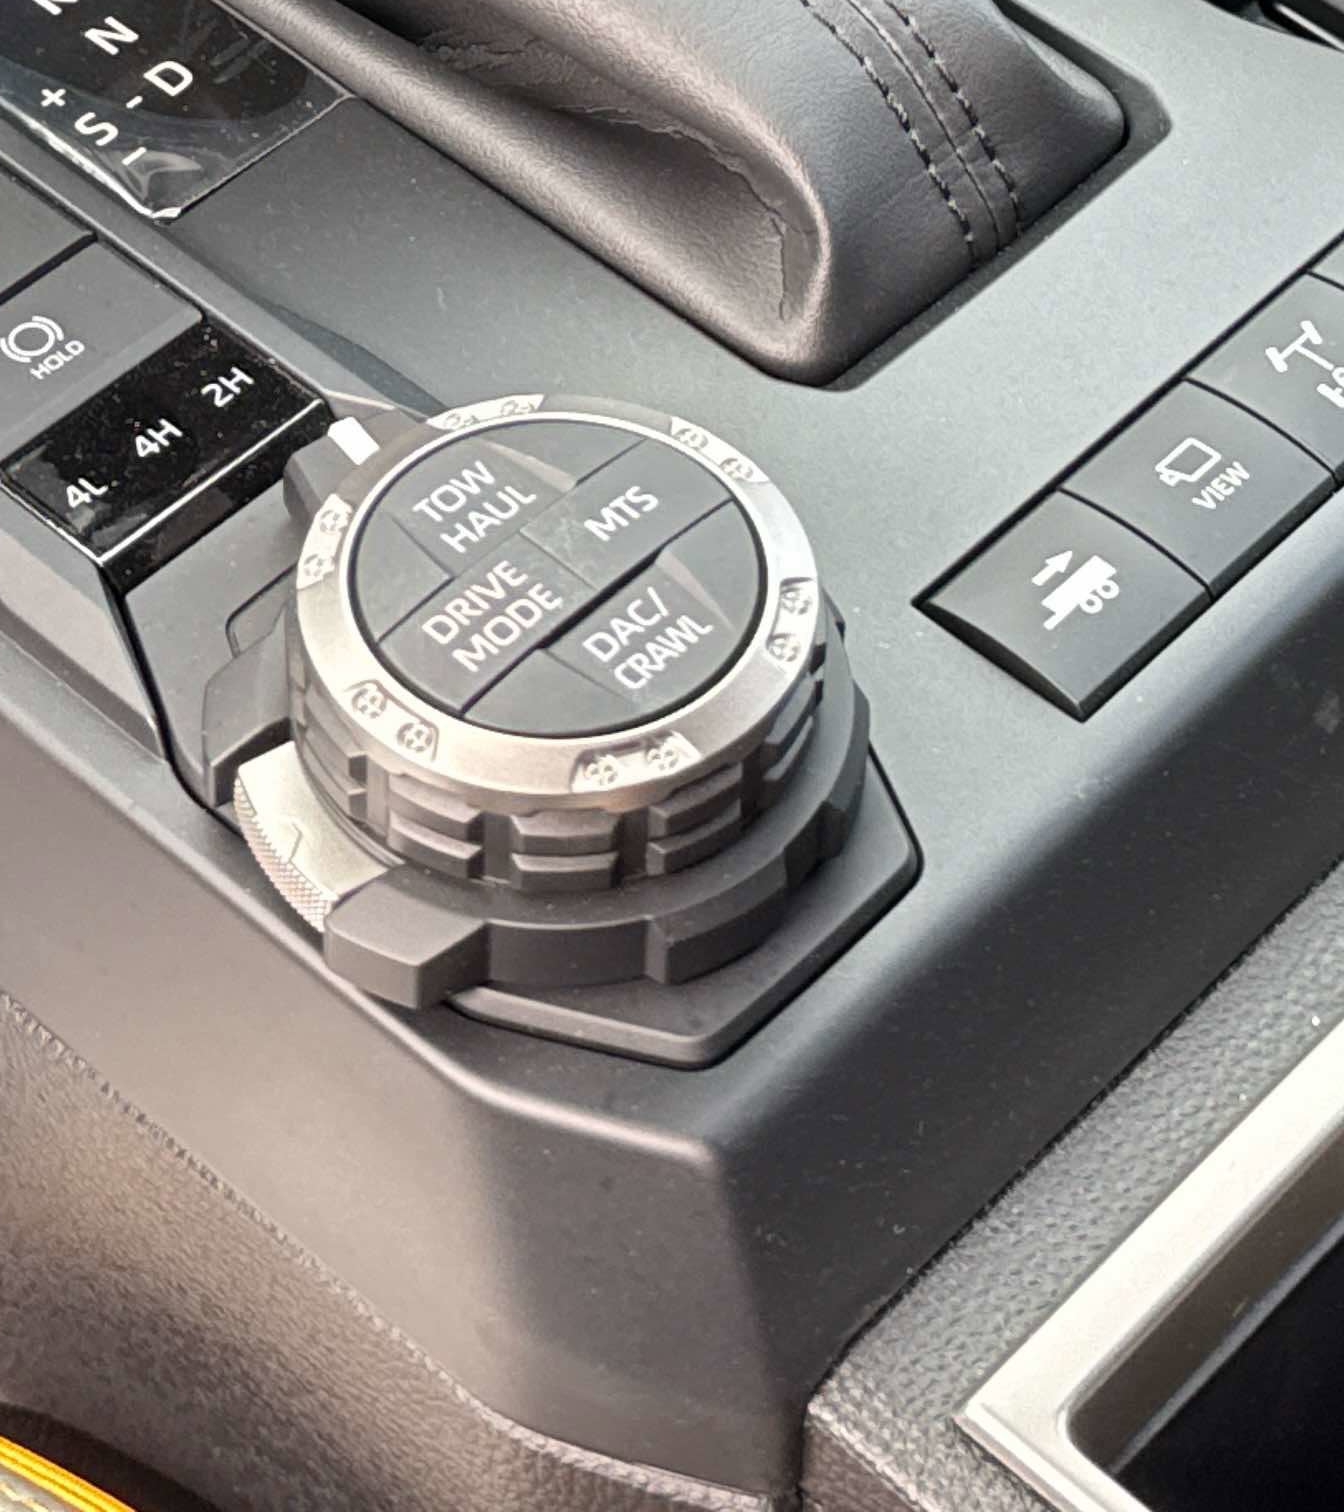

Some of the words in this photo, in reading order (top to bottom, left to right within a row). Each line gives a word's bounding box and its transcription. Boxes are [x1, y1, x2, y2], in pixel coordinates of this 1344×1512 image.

[83, 15, 140, 56] N
[143, 60, 194, 97] D
[73, 111, 119, 147] S
[28, 339, 86, 380] HOLD
[200, 366, 255, 408] 2H
[133, 417, 184, 459] 4H
[64, 476, 109, 509] 4L
[412, 459, 496, 523] TOW
[1191, 460, 1251, 510] VIEW
[439, 485, 538, 554] HAUL
[582, 485, 660, 542] MTS
[421, 559, 529, 645] DRIVE
[581, 586, 670, 663] DAC/
[451, 582, 564, 673] MODE
[613, 614, 715, 690] CRAWL
